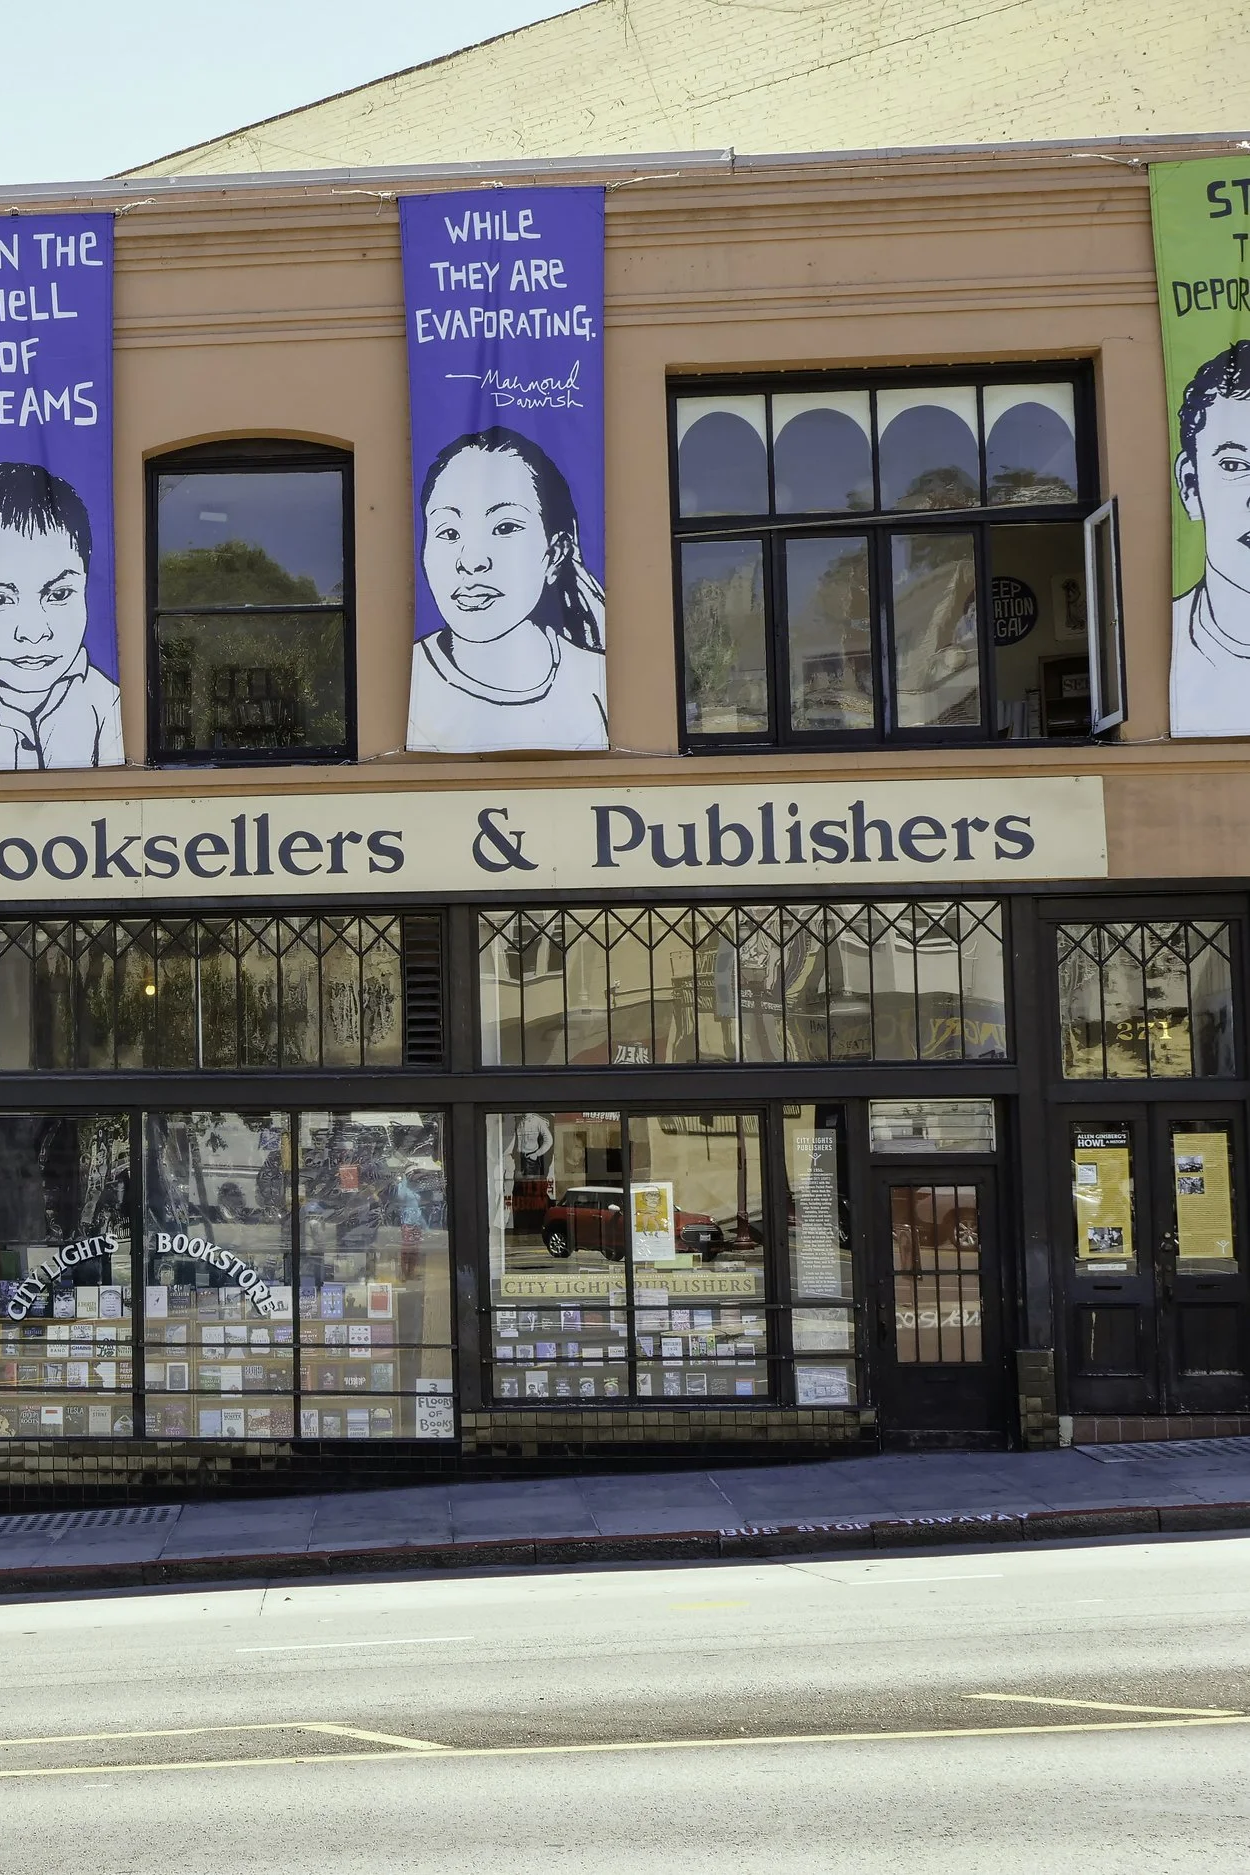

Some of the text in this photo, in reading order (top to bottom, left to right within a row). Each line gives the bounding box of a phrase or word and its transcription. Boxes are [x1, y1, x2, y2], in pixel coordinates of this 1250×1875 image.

[430, 262, 500, 292] THEY
[416, 305, 596, 343] EVAPORATING.
[491, 390, 584, 408] Darwish
[992, 580, 1021, 599] EEP
[471, 807, 539, 873] &
[591, 799, 1036, 868] Publishers
[1116, 1021, 1172, 1040] 271
[1077, 1139, 1106, 1147] HOWL
[7, 1268, 47, 1322] CITY
[41, 1232, 120, 1280] LIGHTS
[156, 1232, 276, 1317] BOOKSTORE
[504, 1282, 548, 1293] CITY
[554, 1280, 624, 1294] LIGHTS
[429, 1383, 438, 1393] 3
[66, 1407, 85, 1415] TESLA
[719, 1527, 780, 1536] BUS
[798, 1522, 870, 1532] STOP
